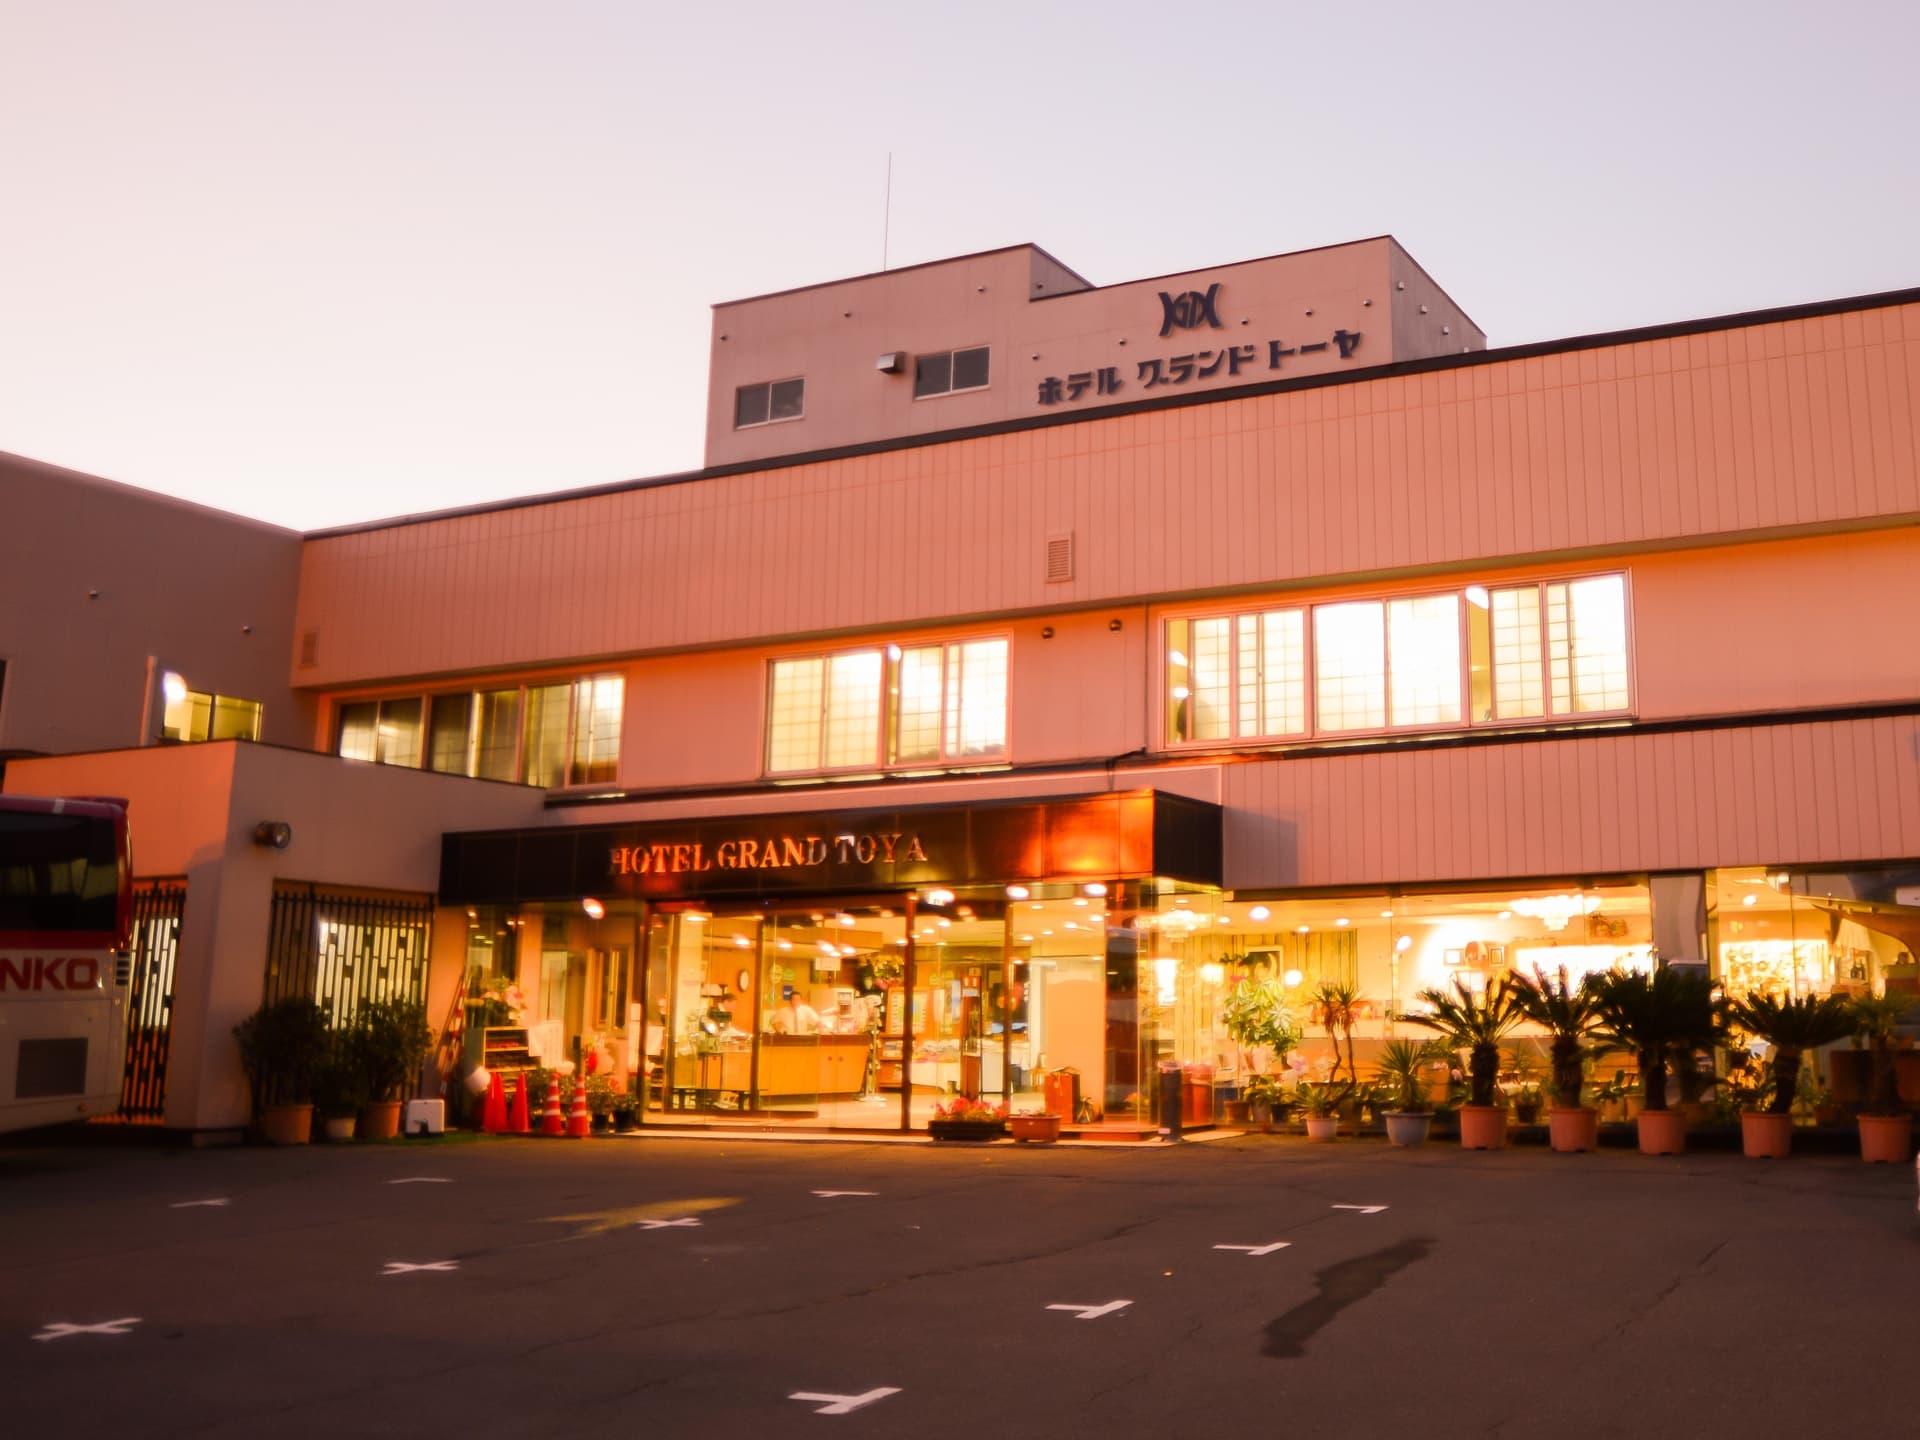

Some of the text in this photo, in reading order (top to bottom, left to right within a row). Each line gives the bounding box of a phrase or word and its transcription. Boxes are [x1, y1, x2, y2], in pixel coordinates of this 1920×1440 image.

[1037, 328, 1362, 405] ホテル グランド トーヤ
[608, 833, 928, 875] HOTEL GRAND TOYA
[0, 957, 99, 991] NKO
